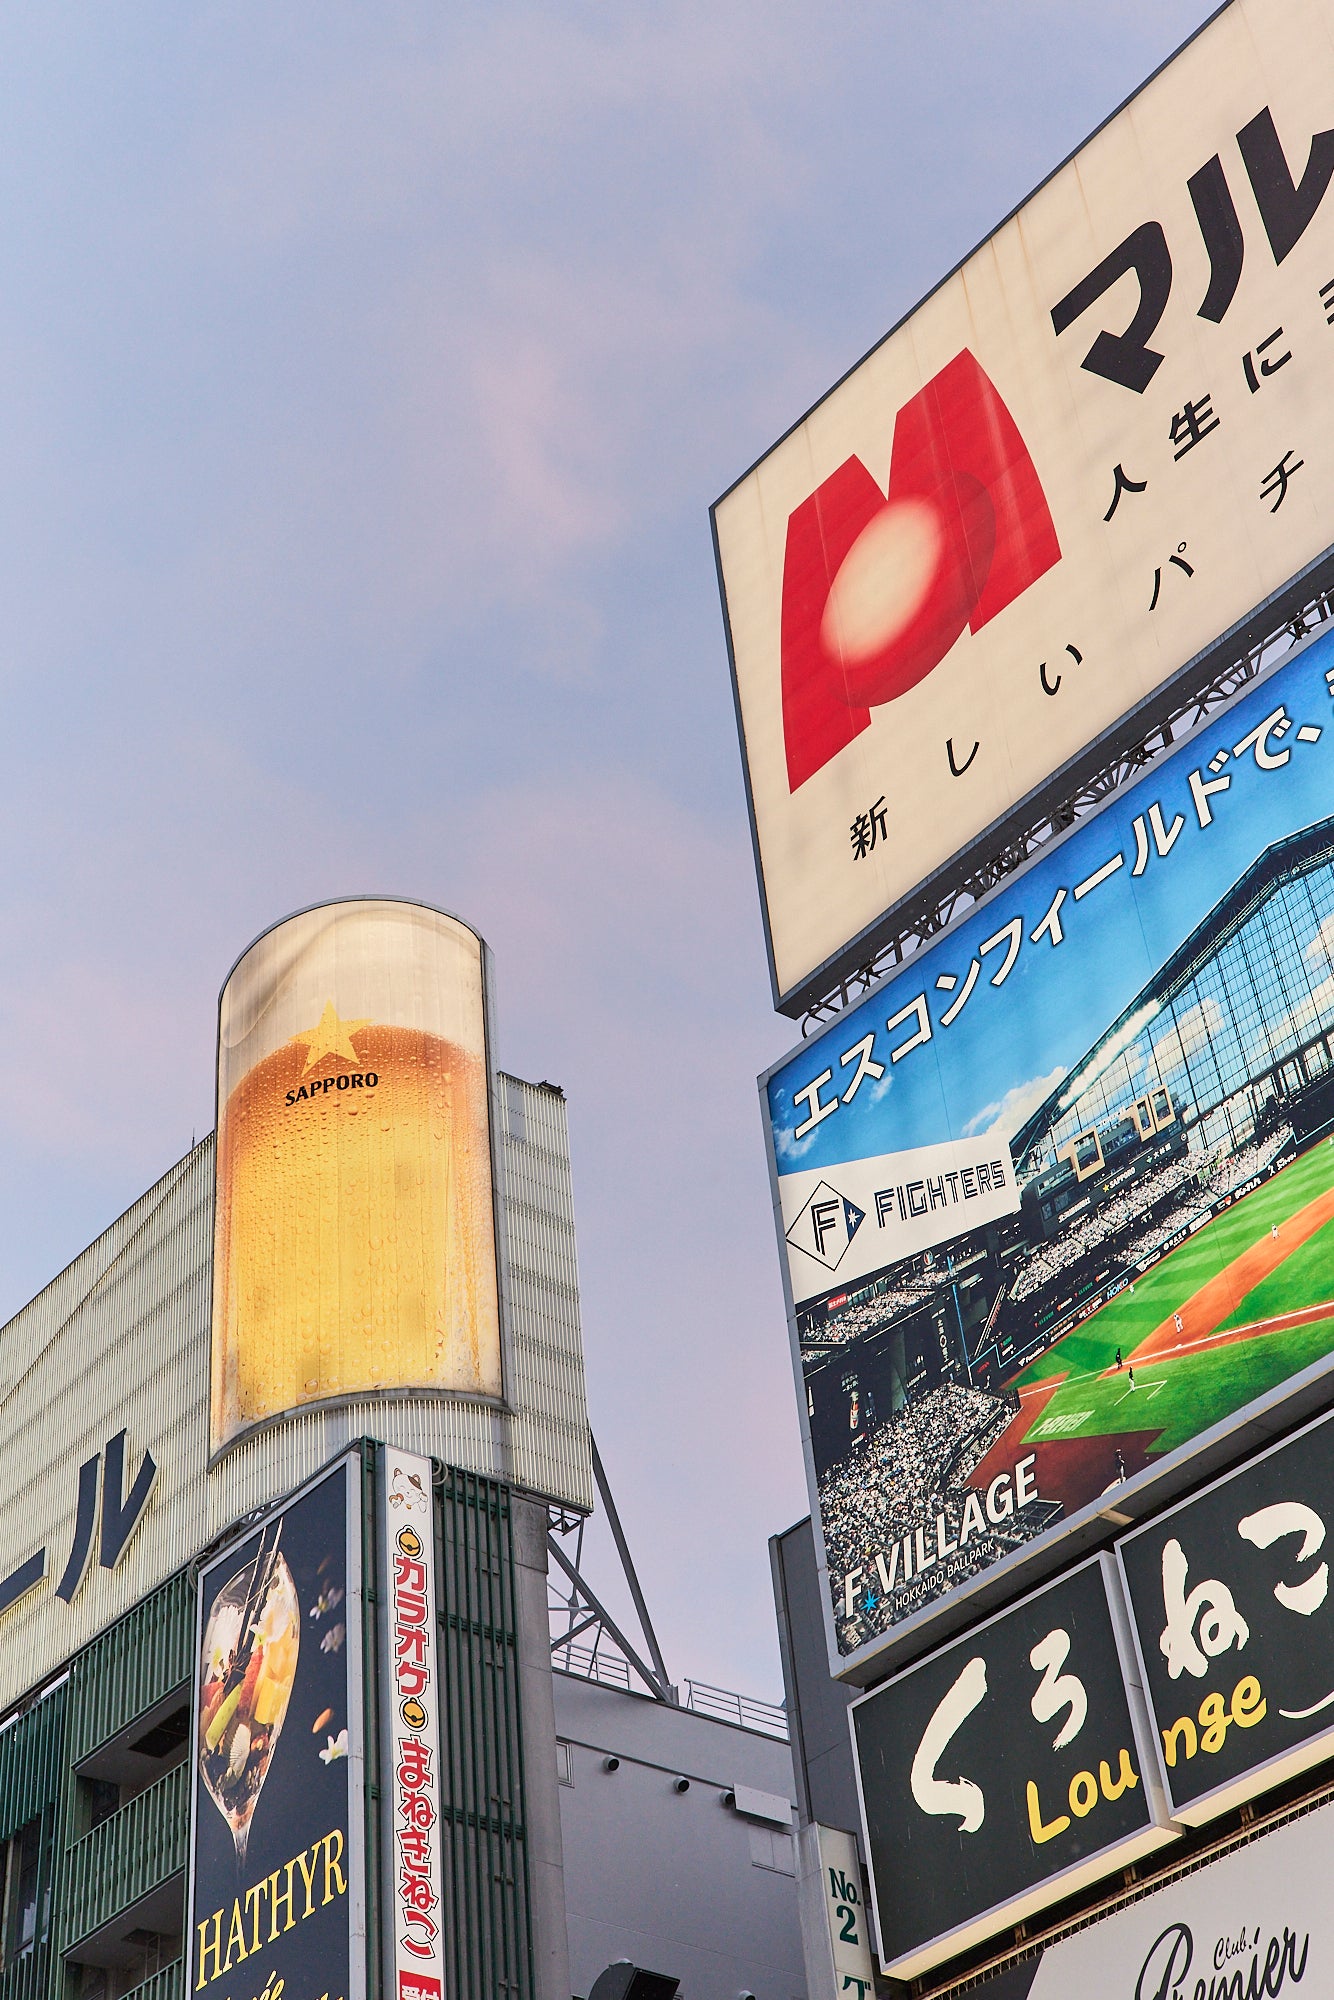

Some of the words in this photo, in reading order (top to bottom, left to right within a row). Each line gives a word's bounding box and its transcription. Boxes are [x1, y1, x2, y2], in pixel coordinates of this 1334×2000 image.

[1050, 105, 1334, 394] マル
[1103, 278, 1334, 522] 人生に
[849, 450, 1304, 861] 新しいパチ
[792, 668, 1334, 1140] エスコンフィールドで、
[285, 1072, 379, 1107] SAPPORO
[873, 1160, 1006, 1229] FIGHTERS
[844, 1566, 863, 1619] F
[874, 1453, 1039, 1596] VILLAGE
[895, 1571, 944, 1612] HOKKAIDO
[946, 1538, 996, 1579] BALLPARK
[394, 1554, 429, 1697] カラオケ
[1025, 1675, 1267, 1844] Lounge
[194, 1828, 348, 1992] HATHYR
[397, 1736, 438, 1958] まねきねこ
[836, 1904, 859, 1946] 2
